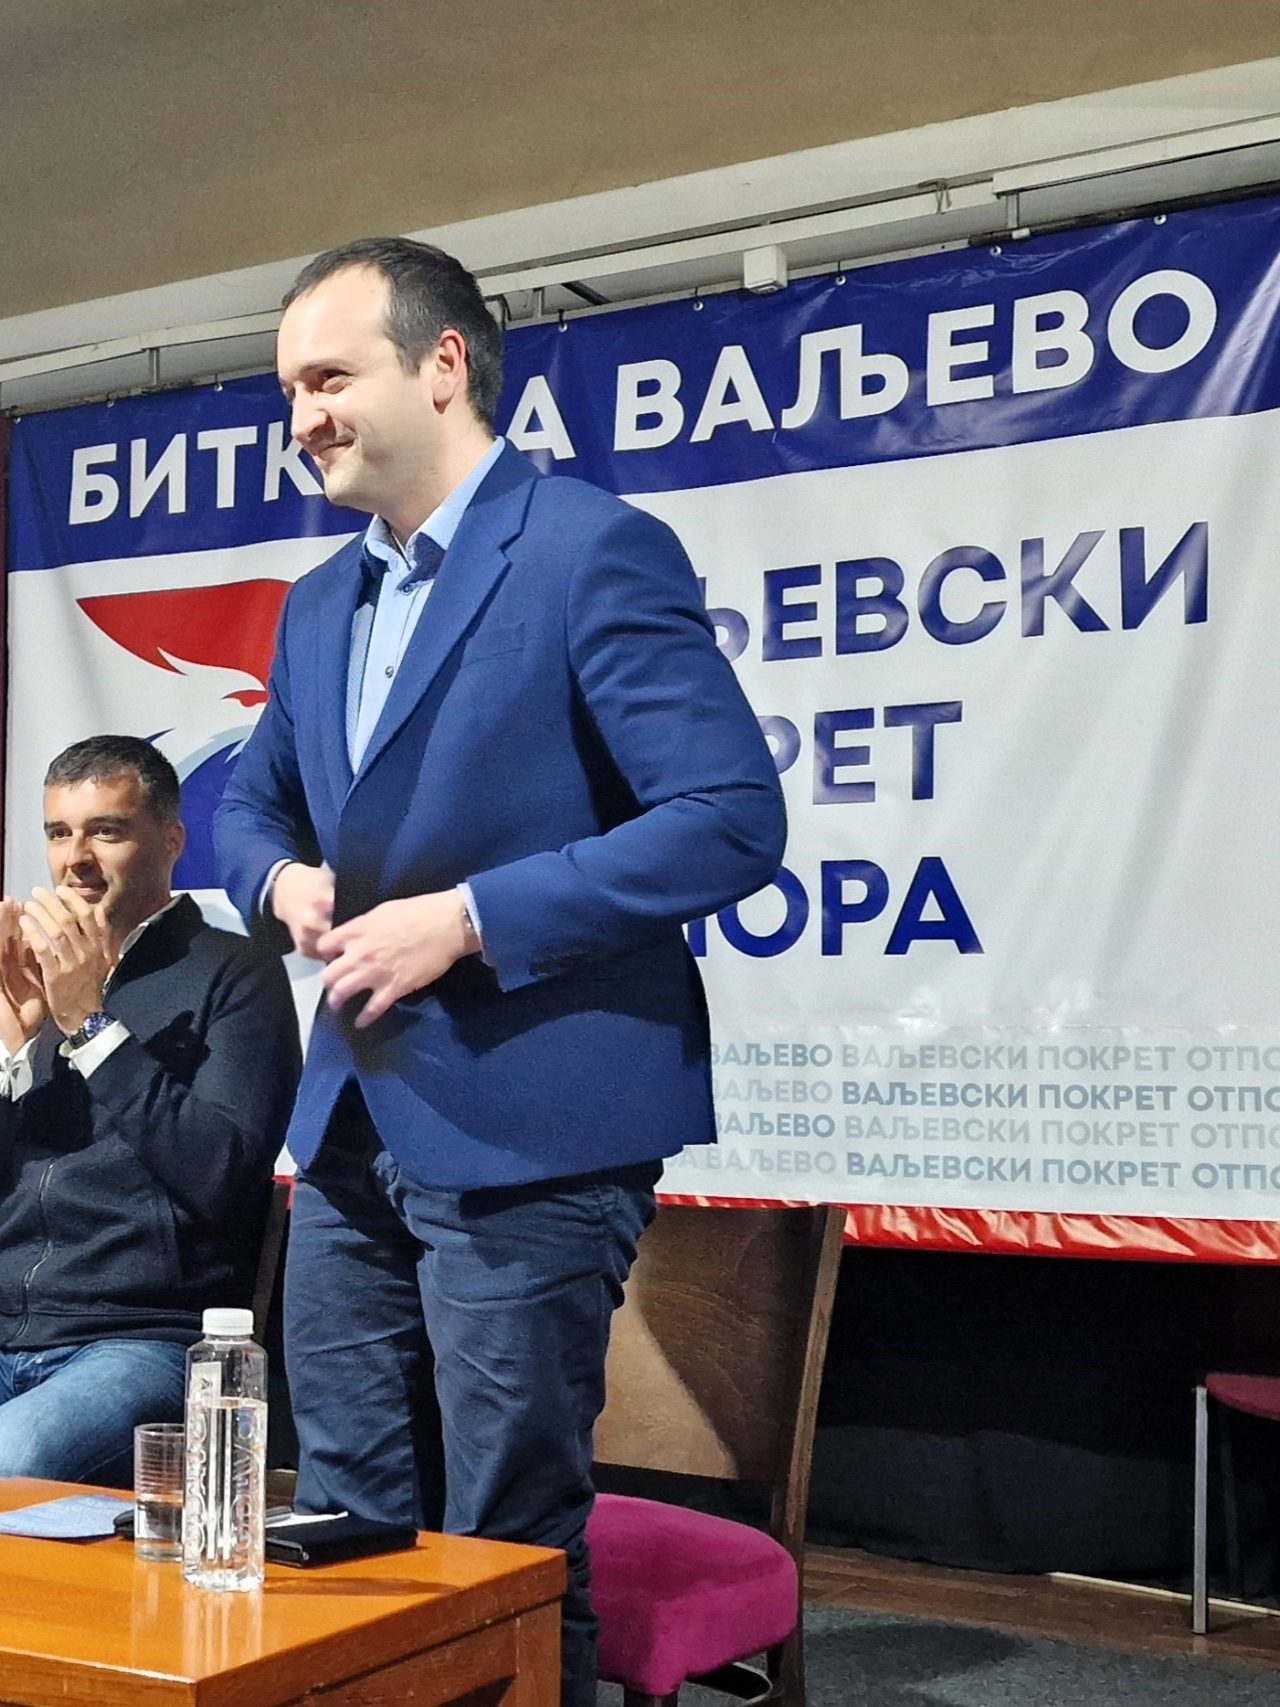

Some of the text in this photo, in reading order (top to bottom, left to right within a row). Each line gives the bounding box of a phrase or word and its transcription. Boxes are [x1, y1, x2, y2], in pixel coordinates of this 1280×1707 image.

[69, 269, 1218, 525] БИТК А ВАЉЕВО
[697, 521, 1210, 664] ЕВСКИ
[687, 856, 984, 958] ОРА
[842, 1044, 1028, 1071] ВАЉЕВСКИ
[1038, 1045, 1176, 1072] ПОКРЕТ
[714, 1078, 832, 1104] АЉЕВО
[842, 1081, 1028, 1109] ВАЉЕВСКИ
[1038, 1083, 1178, 1112] ПОКРЕТ
[716, 1111, 836, 1138] АЉЕВО
[844, 1115, 1031, 1144] ВАЉЕВСКИ
[1041, 1119, 1180, 1148] ПОКРЕТ
[706, 1148, 837, 1175] ВАЉЕВО
[846, 1152, 1032, 1183] ВАЉЕВСКИ
[1042, 1158, 1182, 1188] ПОКРЕТ
